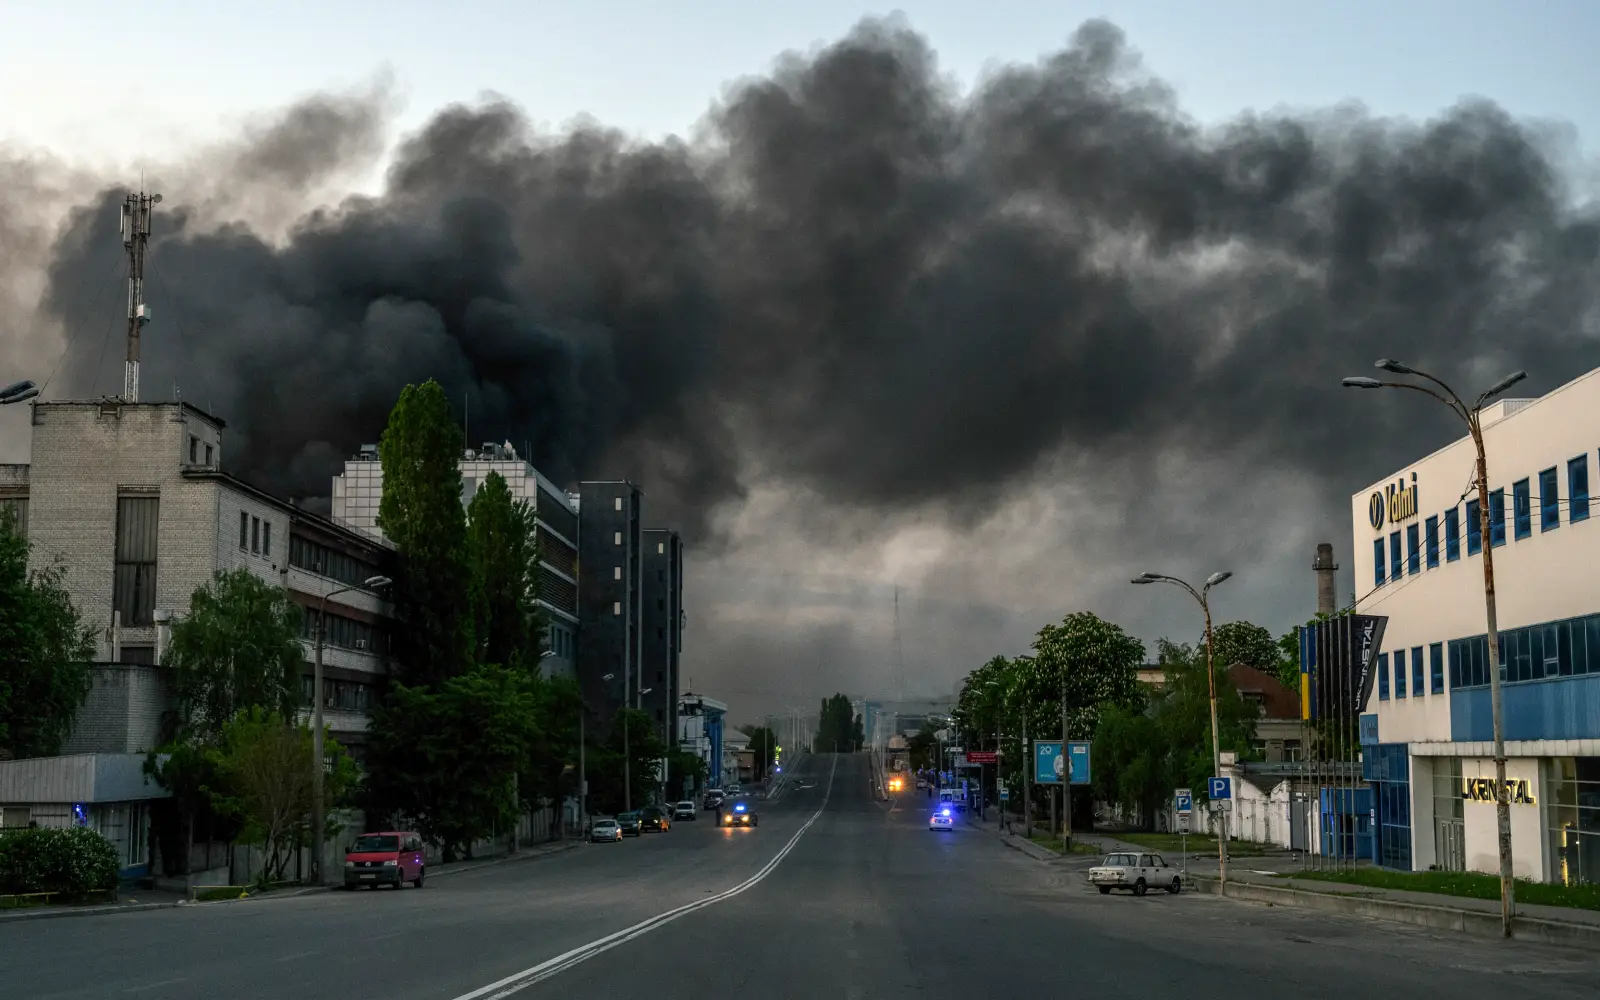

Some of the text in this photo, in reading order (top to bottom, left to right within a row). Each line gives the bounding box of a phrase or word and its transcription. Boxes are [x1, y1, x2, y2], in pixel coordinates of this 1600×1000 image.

[1384, 471, 1418, 524] Valmi
[1214, 780, 1225, 797] P
[1462, 778, 1535, 804] UKRINTAL
[1178, 797, 1189, 808] P
